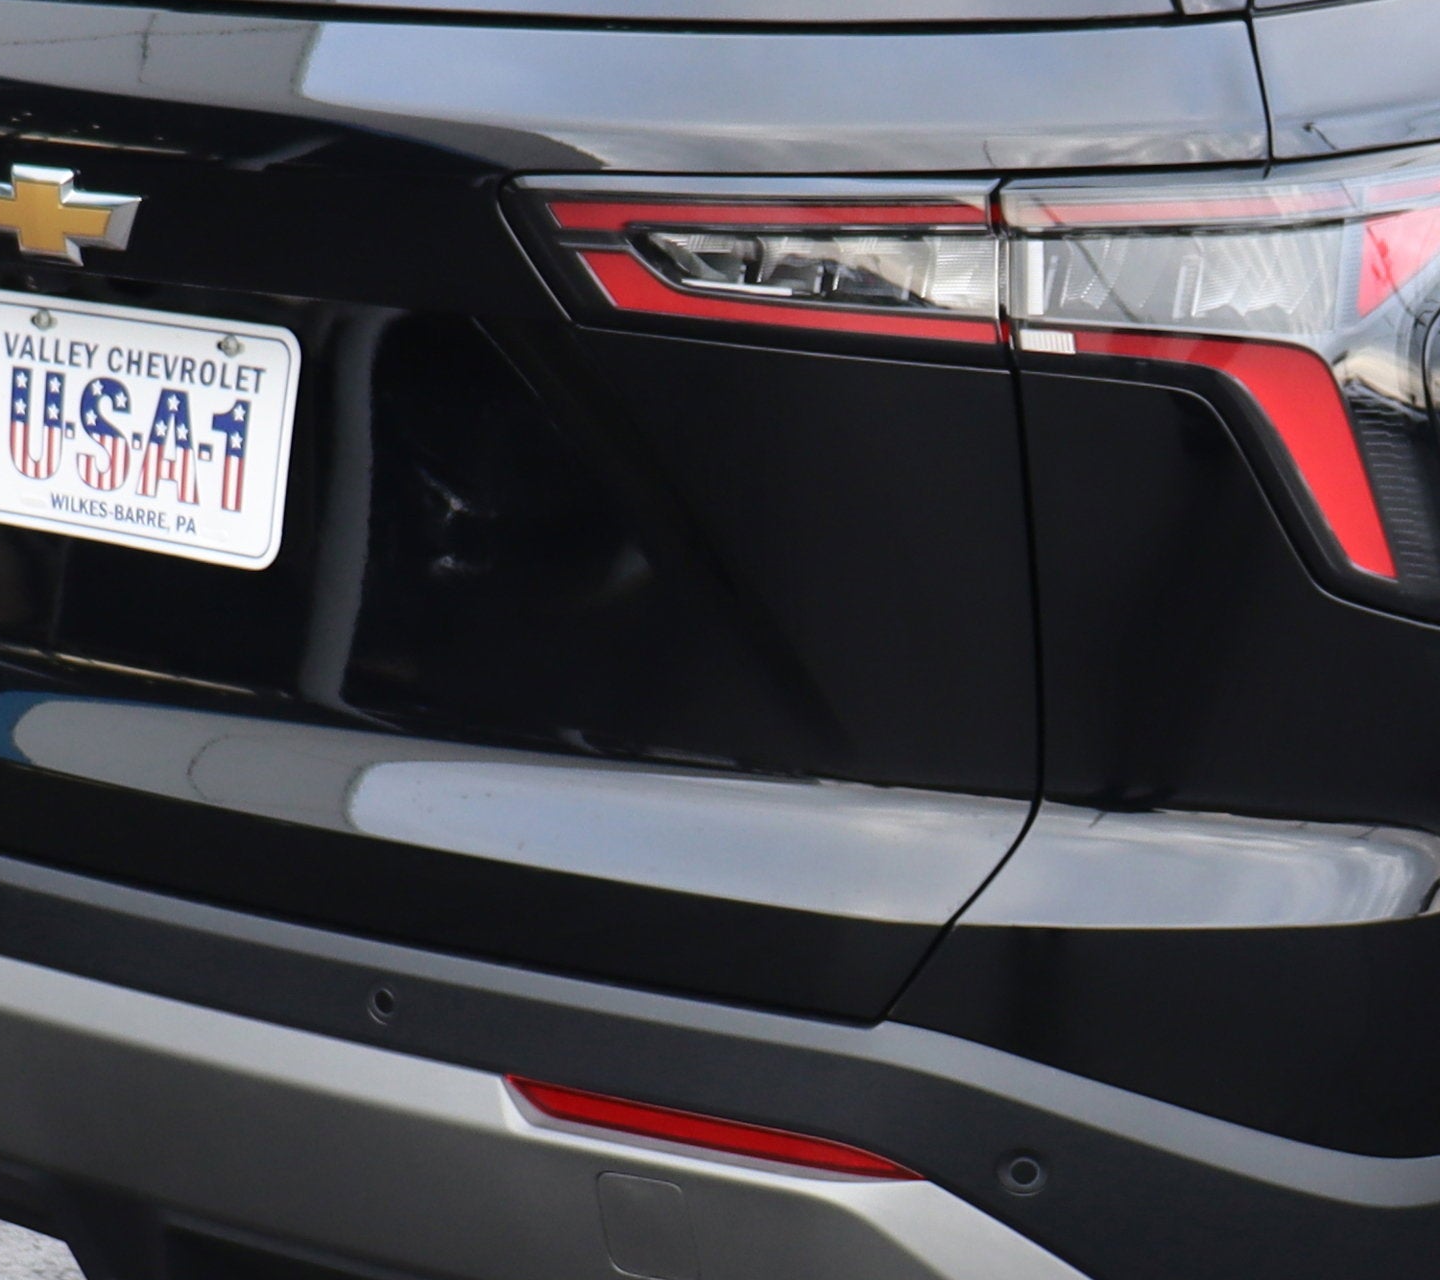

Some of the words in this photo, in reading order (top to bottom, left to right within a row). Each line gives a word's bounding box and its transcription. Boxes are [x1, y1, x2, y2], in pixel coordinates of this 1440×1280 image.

[4, 332, 99, 369] VALLEY
[107, 347, 267, 394] CHEVROLET
[51, 493, 170, 534] WILKES-BARRE,
[176, 514, 197, 535] PA
